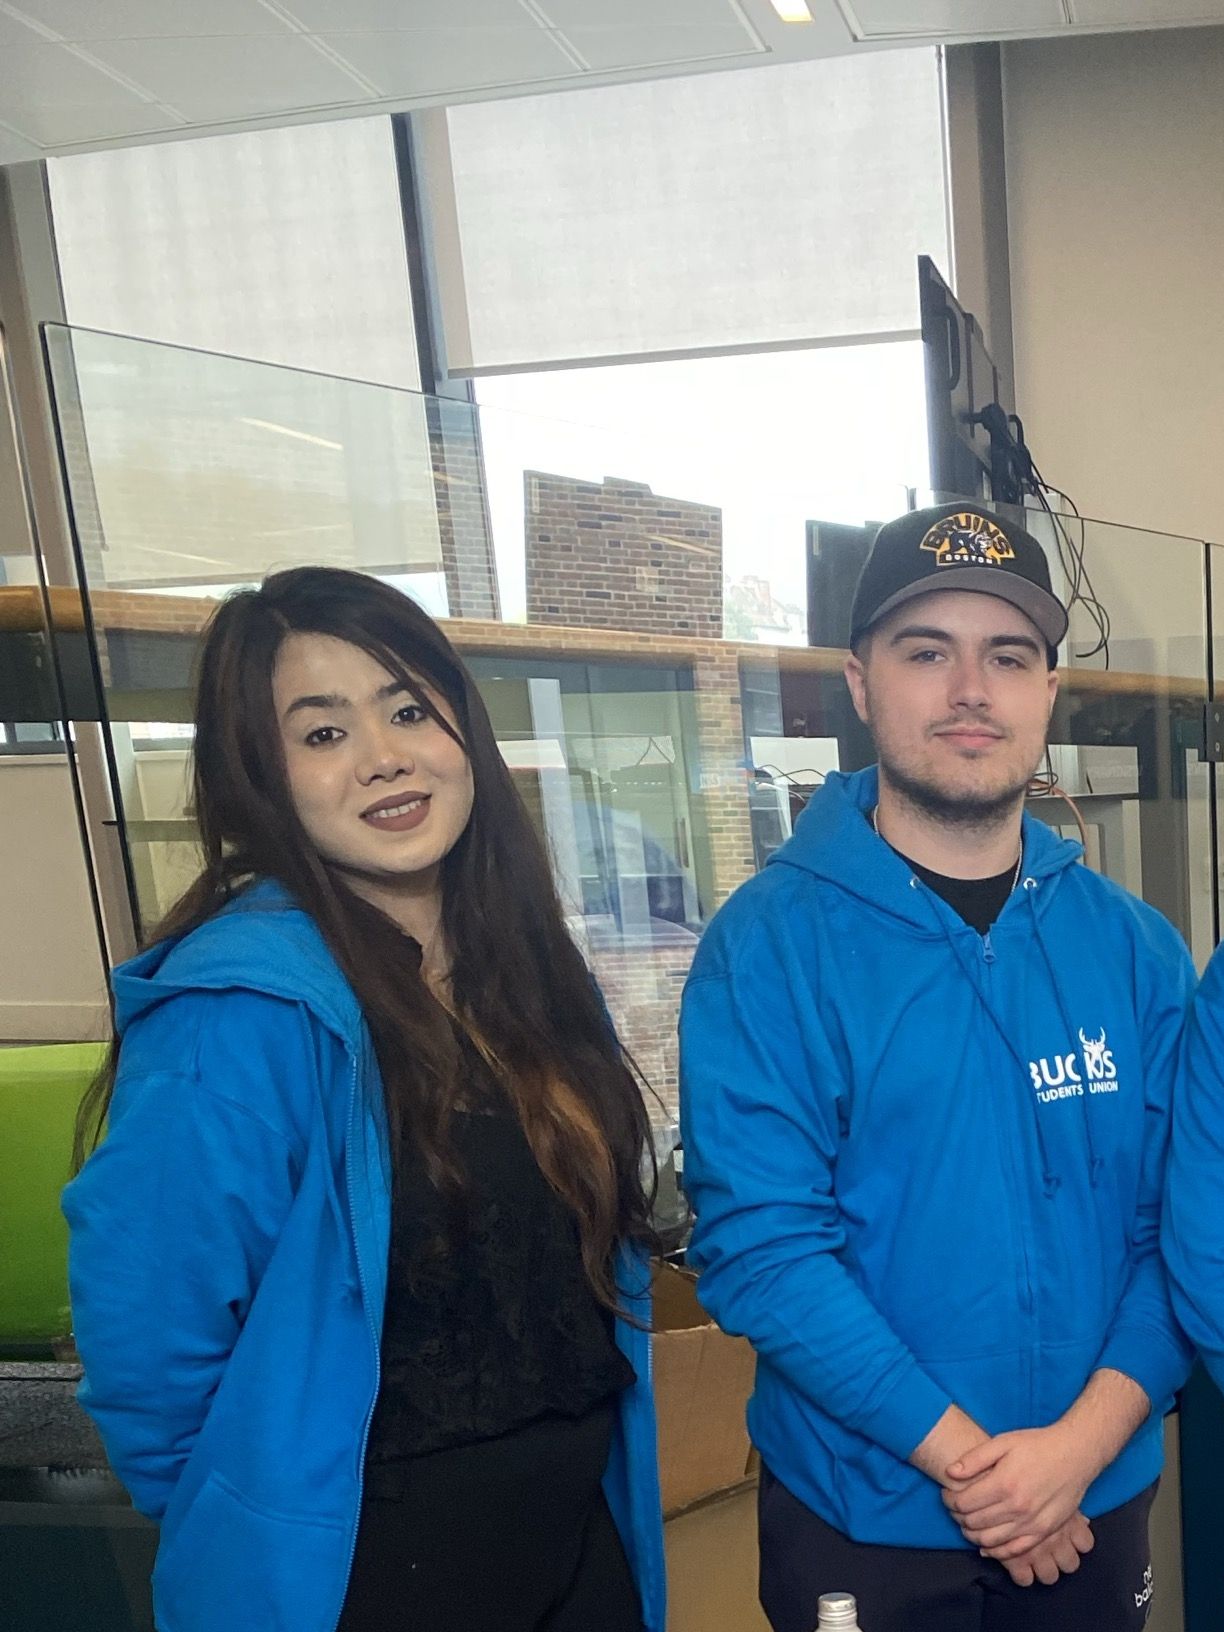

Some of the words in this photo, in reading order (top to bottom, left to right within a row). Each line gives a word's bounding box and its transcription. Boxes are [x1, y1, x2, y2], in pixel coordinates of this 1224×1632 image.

[922, 514, 1011, 555] BRUINS
[945, 553, 993, 564] BOSTON
[1088, 1080, 1119, 1094] UNION
